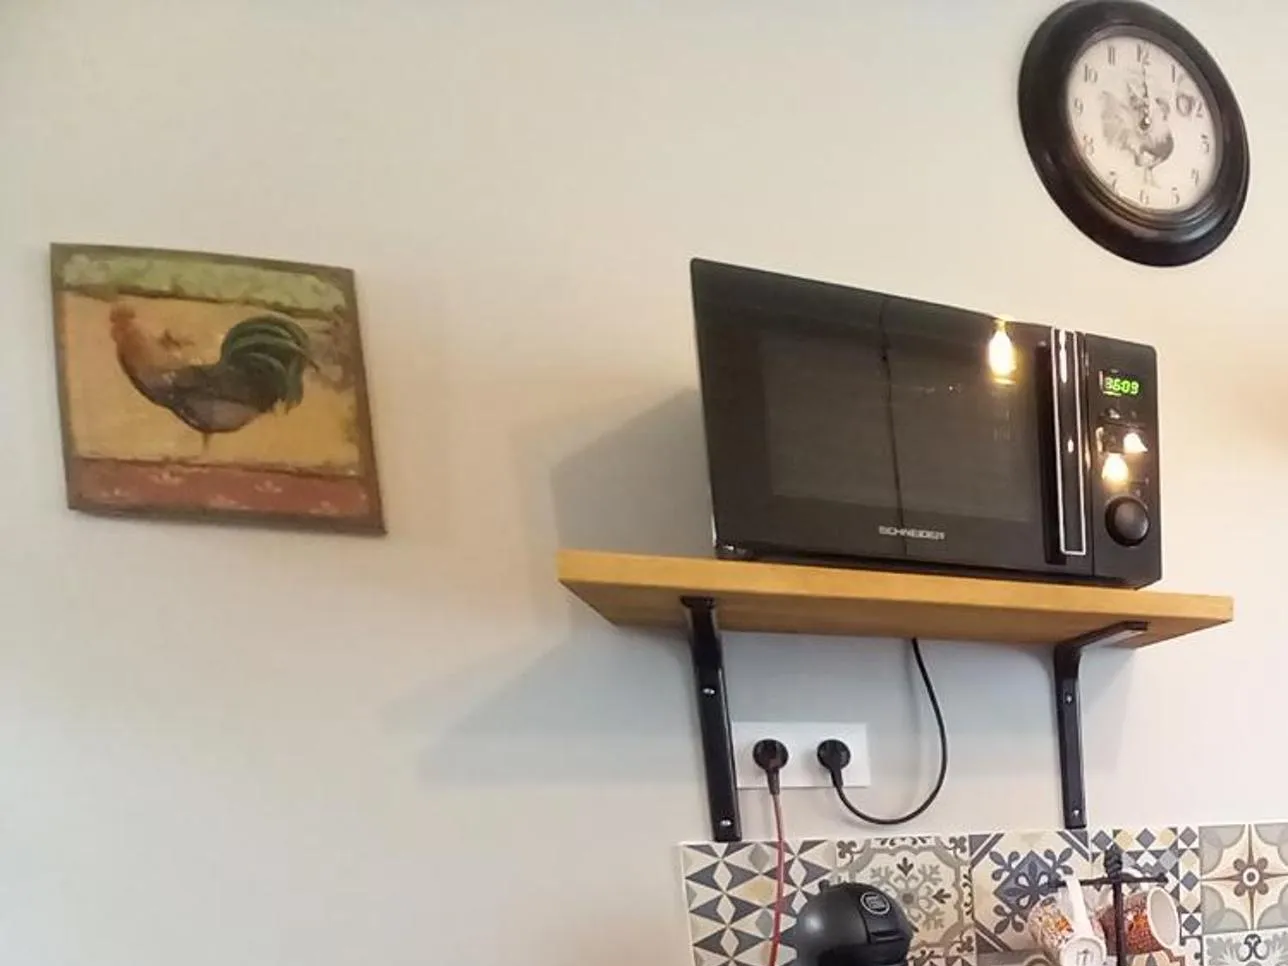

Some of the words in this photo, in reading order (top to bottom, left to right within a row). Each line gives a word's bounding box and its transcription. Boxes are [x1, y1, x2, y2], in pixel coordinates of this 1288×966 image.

[1107, 46, 1117, 67] 11
[1136, 42, 1152, 66] 12
[1083, 63, 1099, 84] 10
